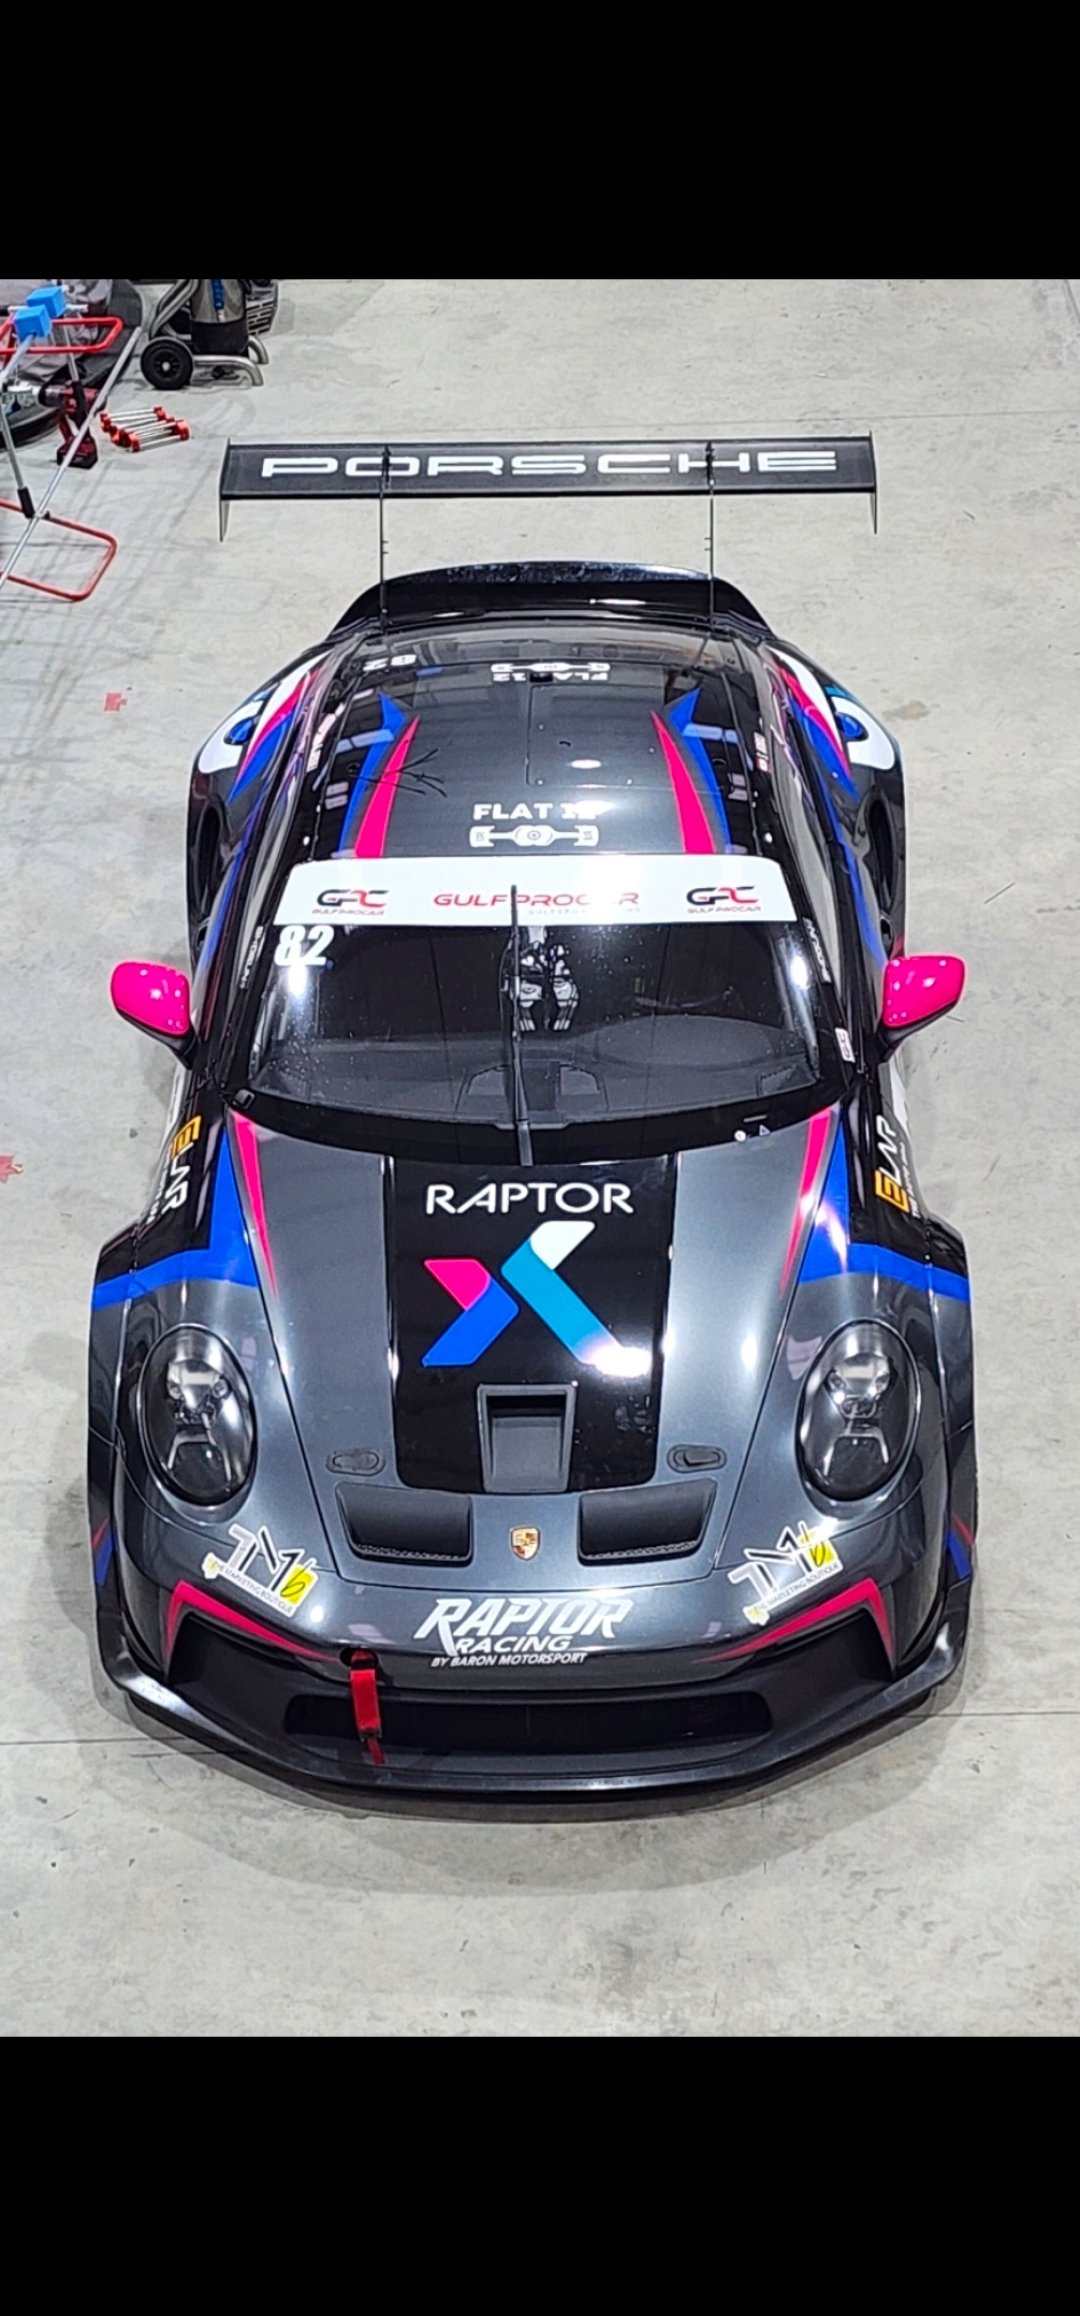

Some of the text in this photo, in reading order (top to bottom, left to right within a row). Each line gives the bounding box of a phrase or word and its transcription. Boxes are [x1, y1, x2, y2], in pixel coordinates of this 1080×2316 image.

[261, 451, 837, 478] PORSCHE
[473, 802, 553, 820] FLAT
[274, 925, 335, 966] 82
[426, 1182, 634, 1214] RAPTOR
[413, 1597, 635, 1657] RAPTOR
[453, 1635, 574, 1654] RACING
[431, 1652, 588, 1668] BY BARON MOTORSPORT
